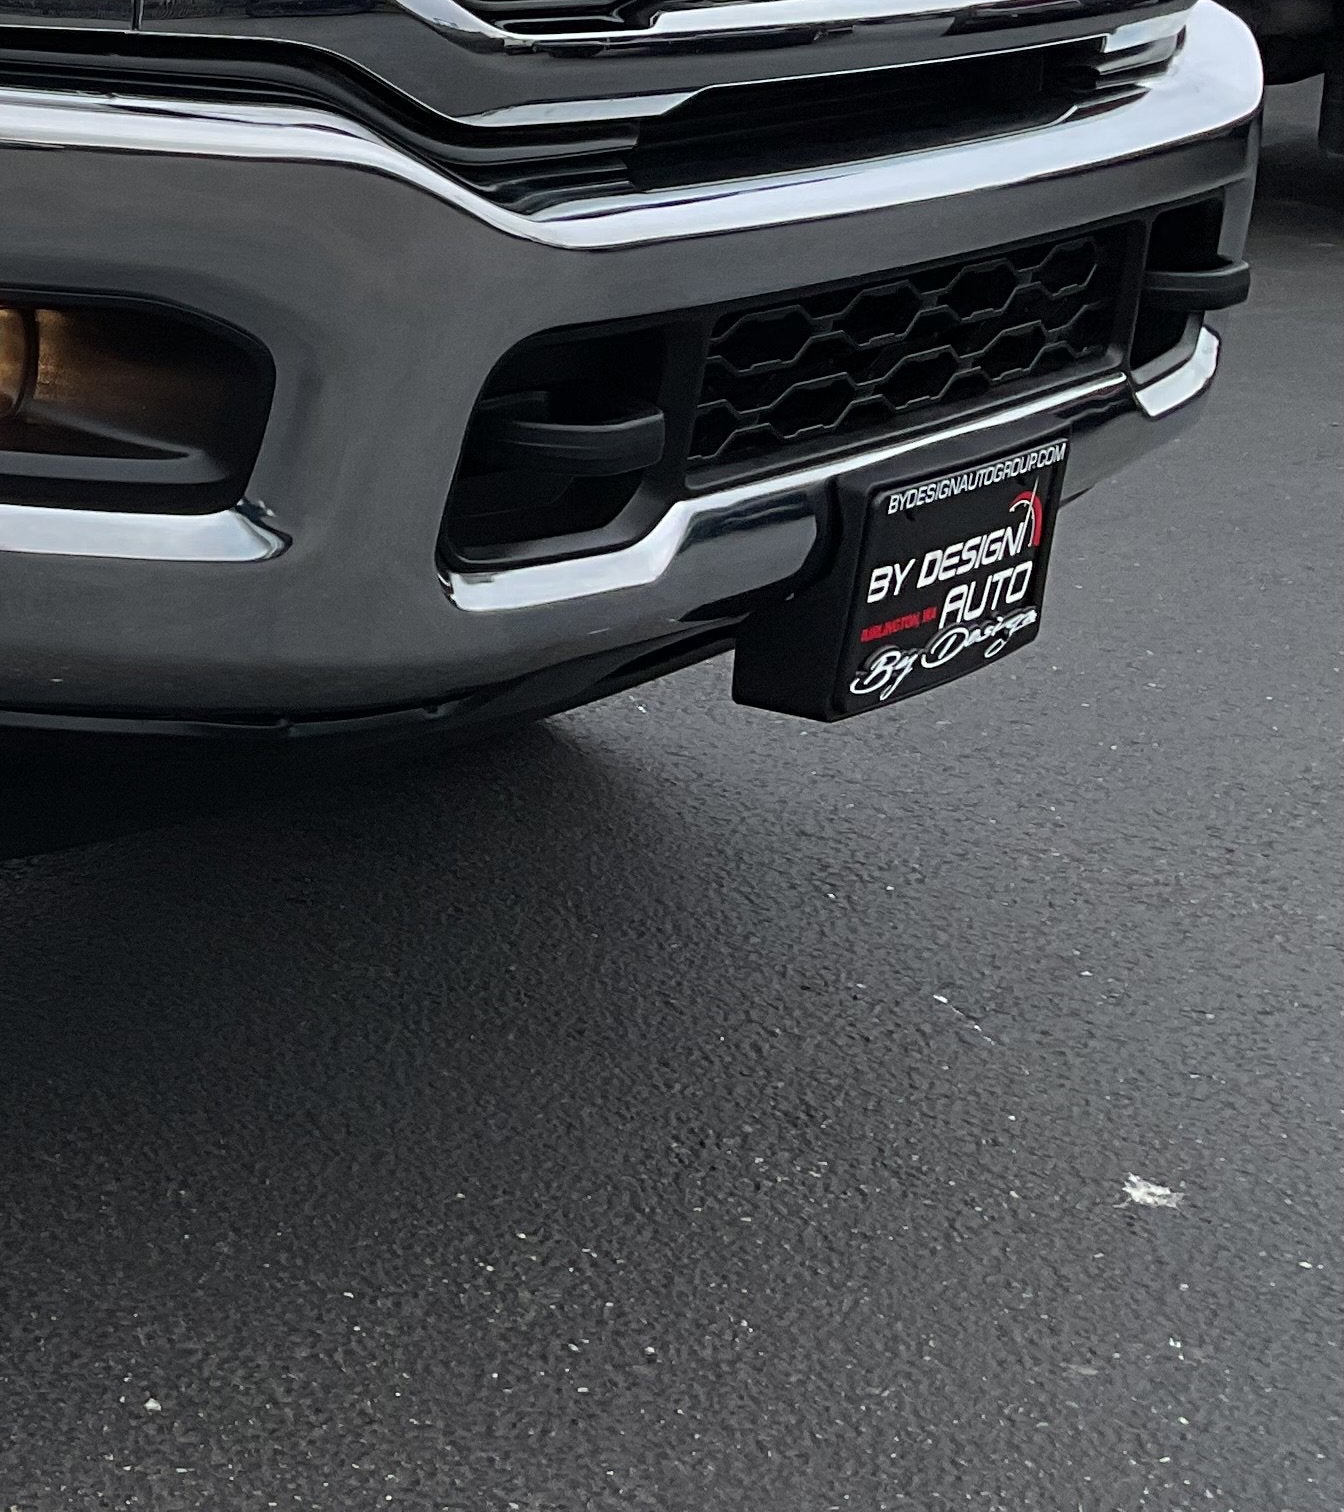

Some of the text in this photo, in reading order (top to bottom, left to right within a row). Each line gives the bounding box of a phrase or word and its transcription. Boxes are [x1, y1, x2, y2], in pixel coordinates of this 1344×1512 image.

[887, 442, 1068, 516] BYDESIGNAUTOGROUP.COM
[866, 520, 1025, 604] BY DESIGN
[938, 560, 1033, 631] AUTO
[848, 609, 1037, 701] By Design
